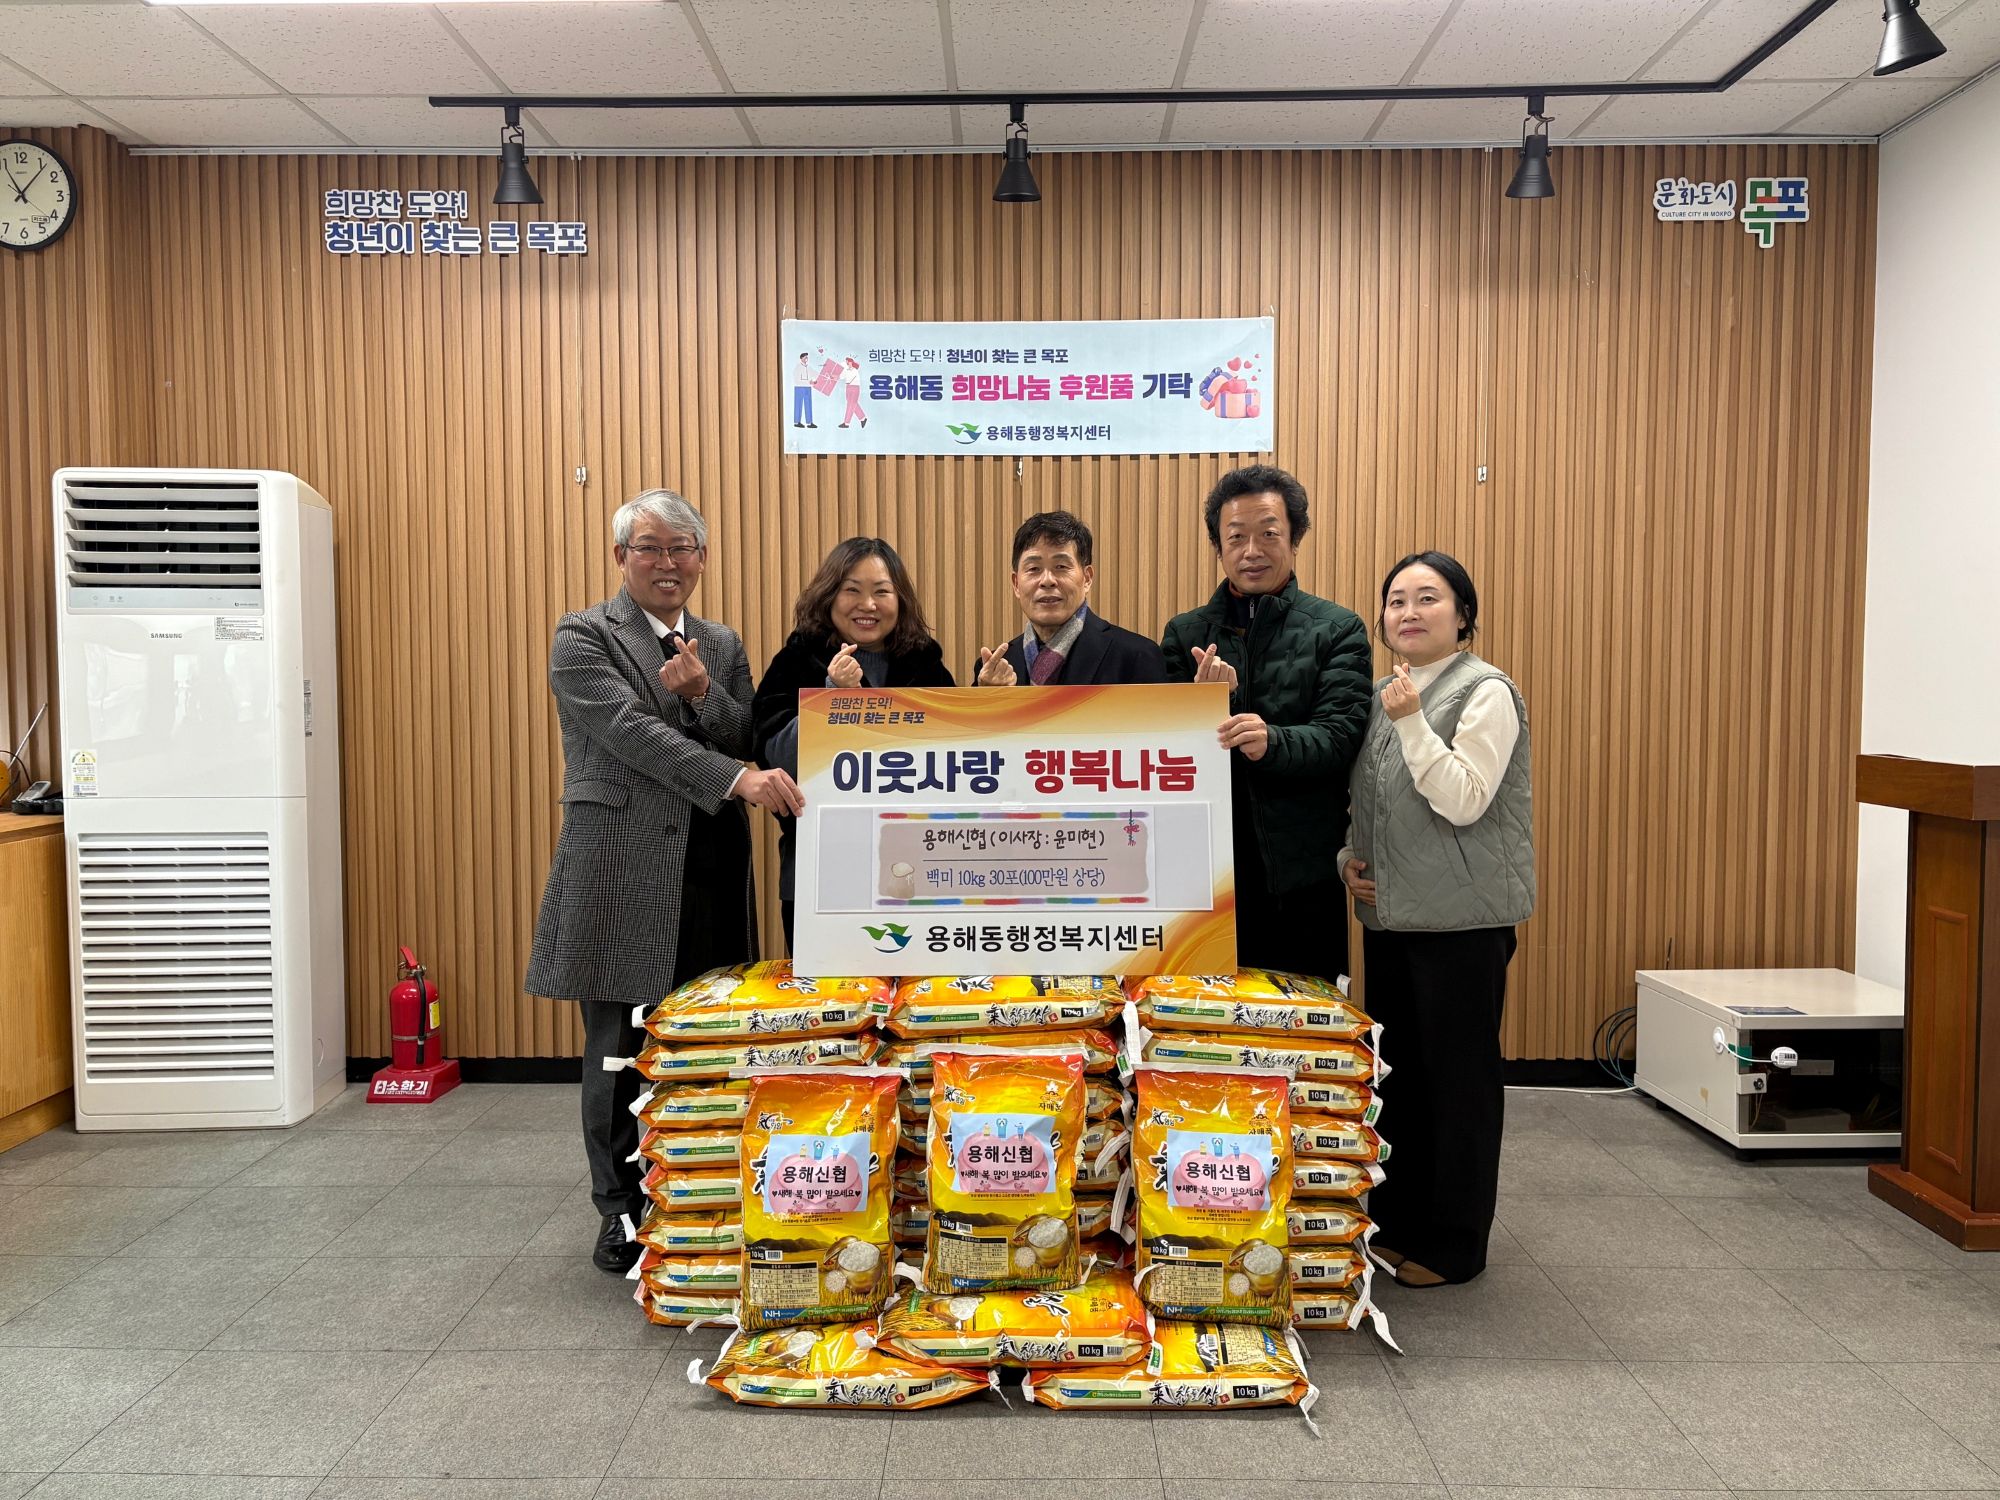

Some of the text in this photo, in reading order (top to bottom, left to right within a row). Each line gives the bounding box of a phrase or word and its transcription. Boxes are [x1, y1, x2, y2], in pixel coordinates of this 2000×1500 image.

[14, 152, 28, 164] 12
[50, 171, 58, 182] 2
[56, 190, 64, 202] 3
[1657, 180, 1734, 208] 문화도시
[326, 190, 466, 216] 희망찬 도약!
[50, 209, 58, 220] 4
[2, 222, 10, 234] 7
[20, 227, 28, 238] 6
[326, 222, 587, 252] 청년이 찾는 큰 목포
[868, 349, 906, 363] 희망찬
[946, 348, 988, 364] 청년이
[992, 348, 1019, 364] 찾는
[1024, 350, 1036, 363] 큰
[1041, 349, 1068, 363] 목포
[869, 372, 1192, 401] 용해동 희망나눔 후원품 기탁
[986, 424, 1111, 442] 용해동행정복지센터
[830, 696, 893, 710] 희망찬 도약!
[828, 711, 926, 724] 청년이 찾는 큰 목포
[832, 749, 1197, 794] 이웃사랑 행복나눔
[926, 868, 953, 888] 백미
[958, 871, 985, 888] 10kg
[1072, 867, 1105, 888] 상당)
[926, 924, 1164, 952] 용해동행정복지센터
[834, 1012, 843, 1020] kg
[1319, 1015, 1328, 1023] kg
[1327, 1060, 1336, 1068] kg
[387, 1080, 428, 1094] 소화기
[968, 1145, 1033, 1163] 용해신협
[782, 1166, 847, 1183] 용해신협
[965, 1170, 1042, 1180] 새해 복 많이 받으세요
[1186, 1162, 1251, 1181] 용해신협
[778, 1190, 792, 1198] 새해
[807, 1189, 821, 1199] 많이
[825, 1189, 855, 1199] 받으세요
[1182, 1185, 1260, 1197] 새해 복 많이 받으세요
[948, 1220, 955, 1230] kg
[1316, 1221, 1325, 1229] kg
[758, 1251, 764, 1259] kg
[1160, 1247, 1167, 1255] kg
[1313, 1268, 1322, 1276] kg
[765, 1309, 780, 1317] NH
[1315, 1309, 1324, 1318] kg
[1091, 1347, 1100, 1356] kg
[1236, 1388, 1257, 1397] 10 kg
